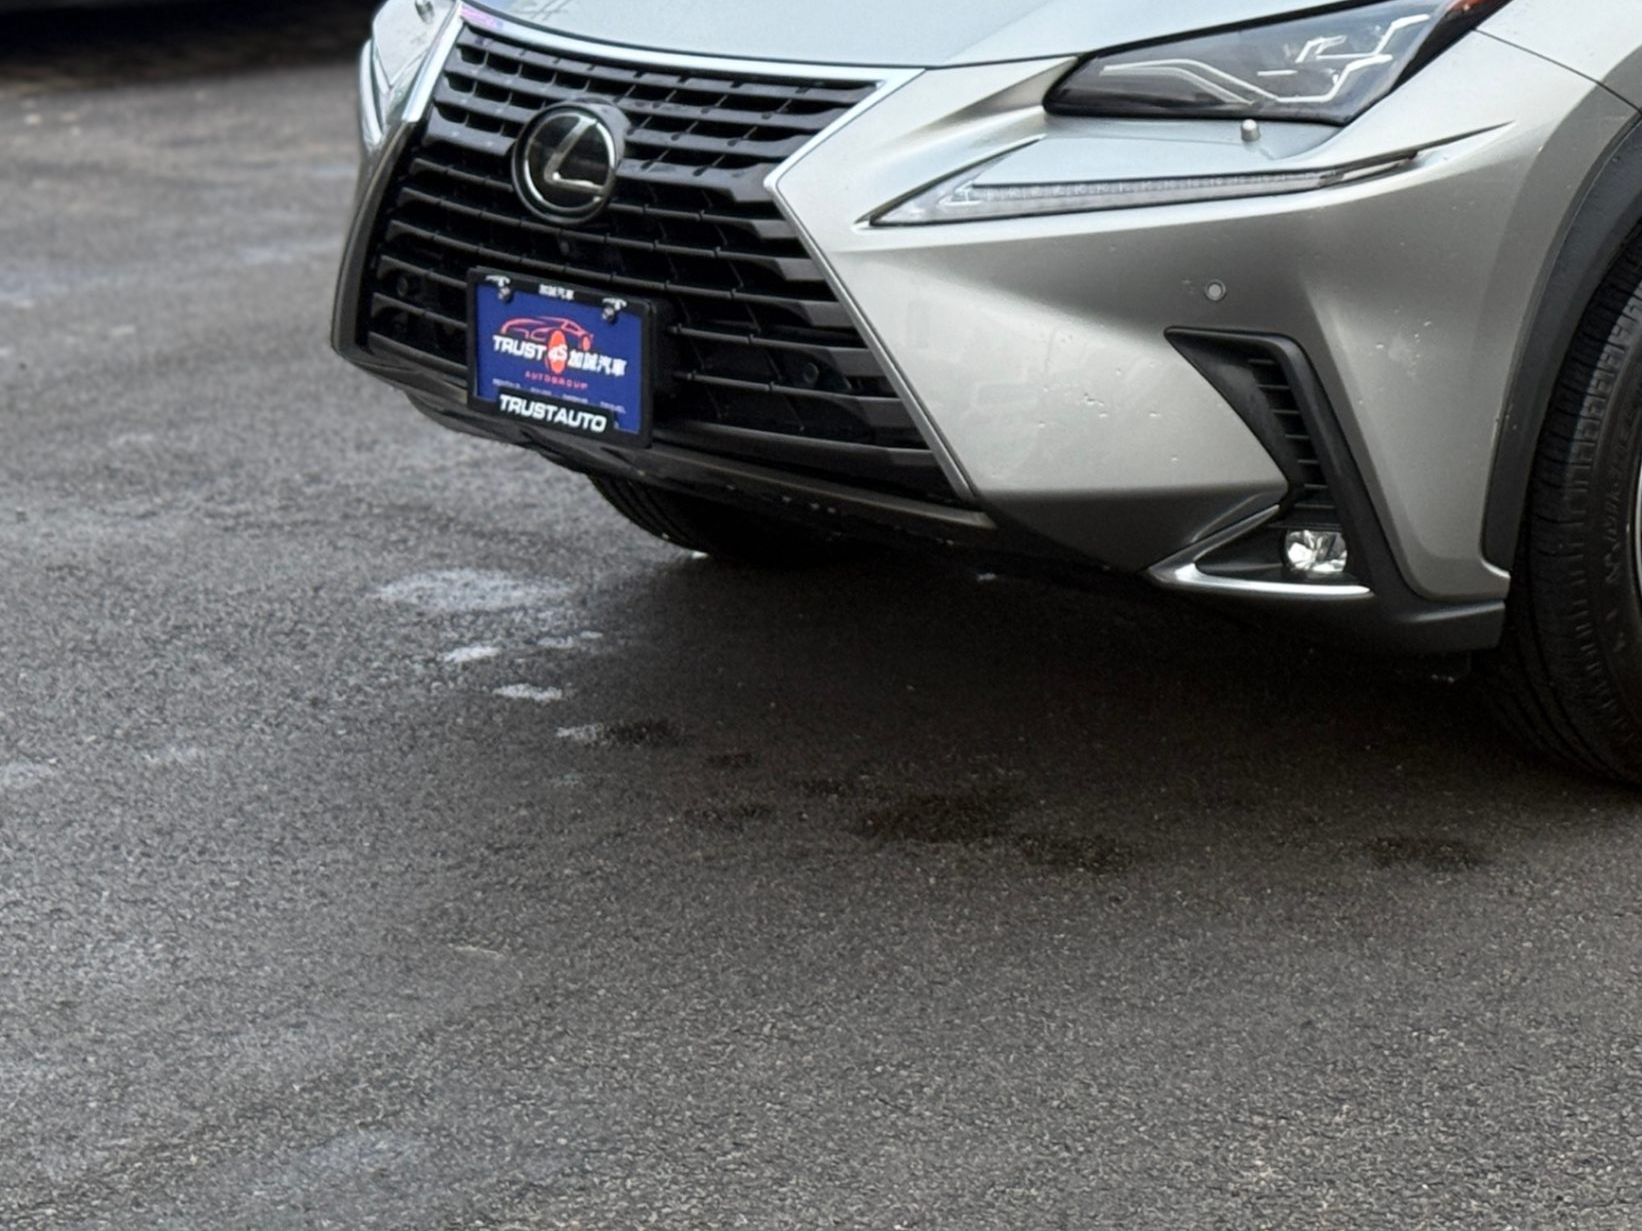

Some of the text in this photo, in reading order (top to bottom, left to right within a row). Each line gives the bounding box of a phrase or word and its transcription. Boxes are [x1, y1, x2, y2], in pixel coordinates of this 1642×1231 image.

[492, 334, 547, 361] TRUST
[524, 370, 589, 390] AUTOGROUP
[499, 393, 608, 433] TRUSTAUTO
